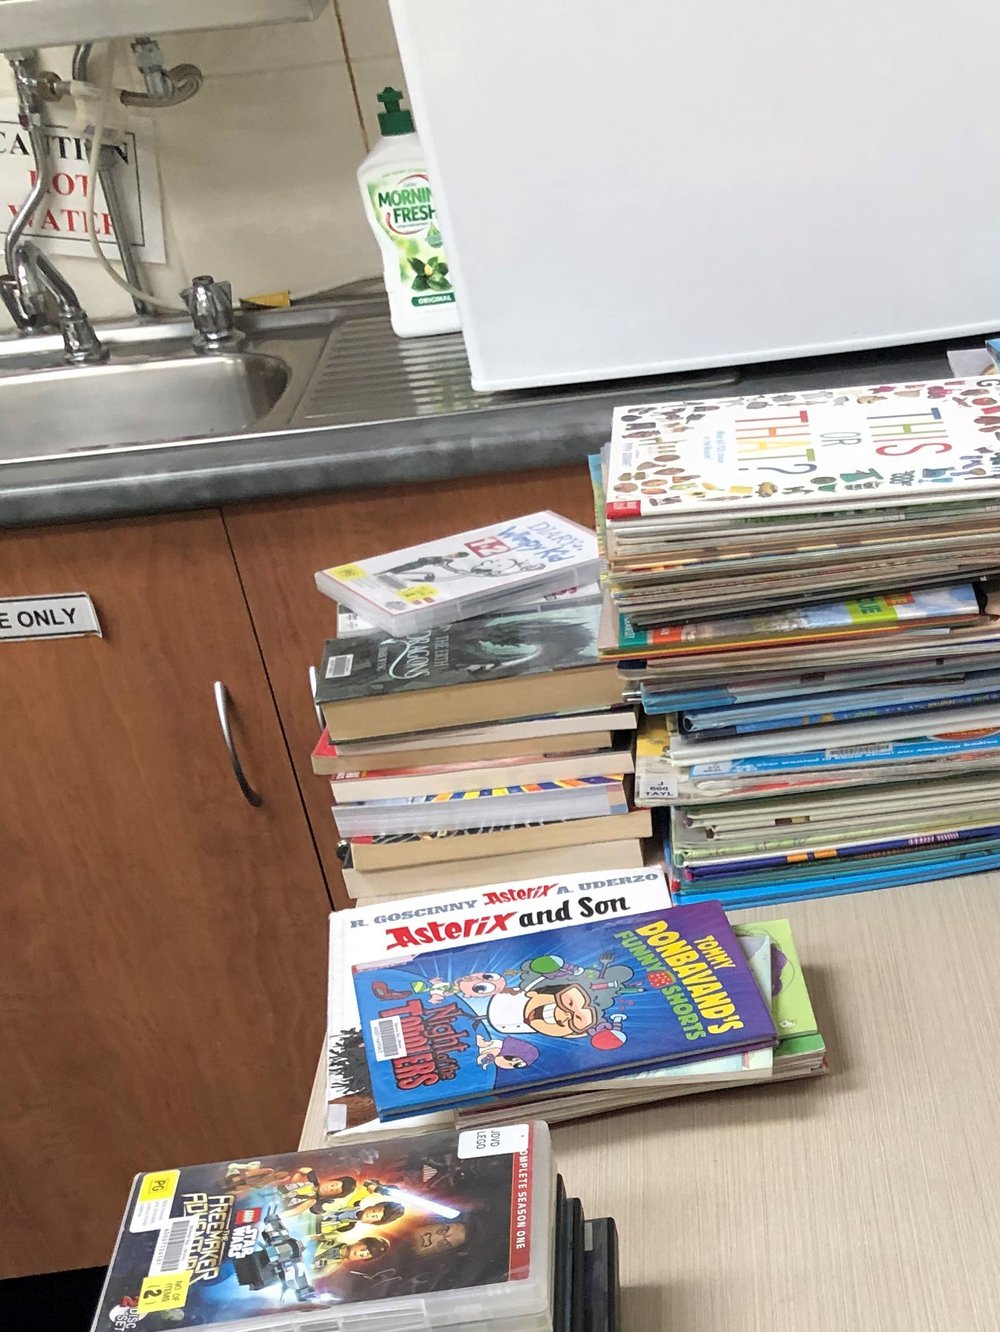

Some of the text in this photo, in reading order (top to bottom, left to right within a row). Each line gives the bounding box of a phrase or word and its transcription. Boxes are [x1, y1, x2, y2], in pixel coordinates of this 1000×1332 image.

[734, 410, 818, 475] THAT?
[819, 430, 862, 447] OR
[866, 407, 953, 457] THIS
[17, 607, 76, 628] ONLY
[350, 873, 659, 929] R. GOSCINNY Asterix A. UDERZO
[385, 895, 631, 951] Asterix and Son
[635, 920, 745, 1034] DONBAVAND'S
[693, 934, 736, 970] TOMMY
[613, 930, 707, 1041] FUNNY SHORTS
[476, 1131, 487, 1150] LEGO
[151, 1179, 166, 1192] PG
[516, 1149, 528, 1250] OMPLETE SEASON ONE
[189, 1194, 235, 1285] FREEMAKER
[243, 1225, 259, 1256] STAR
